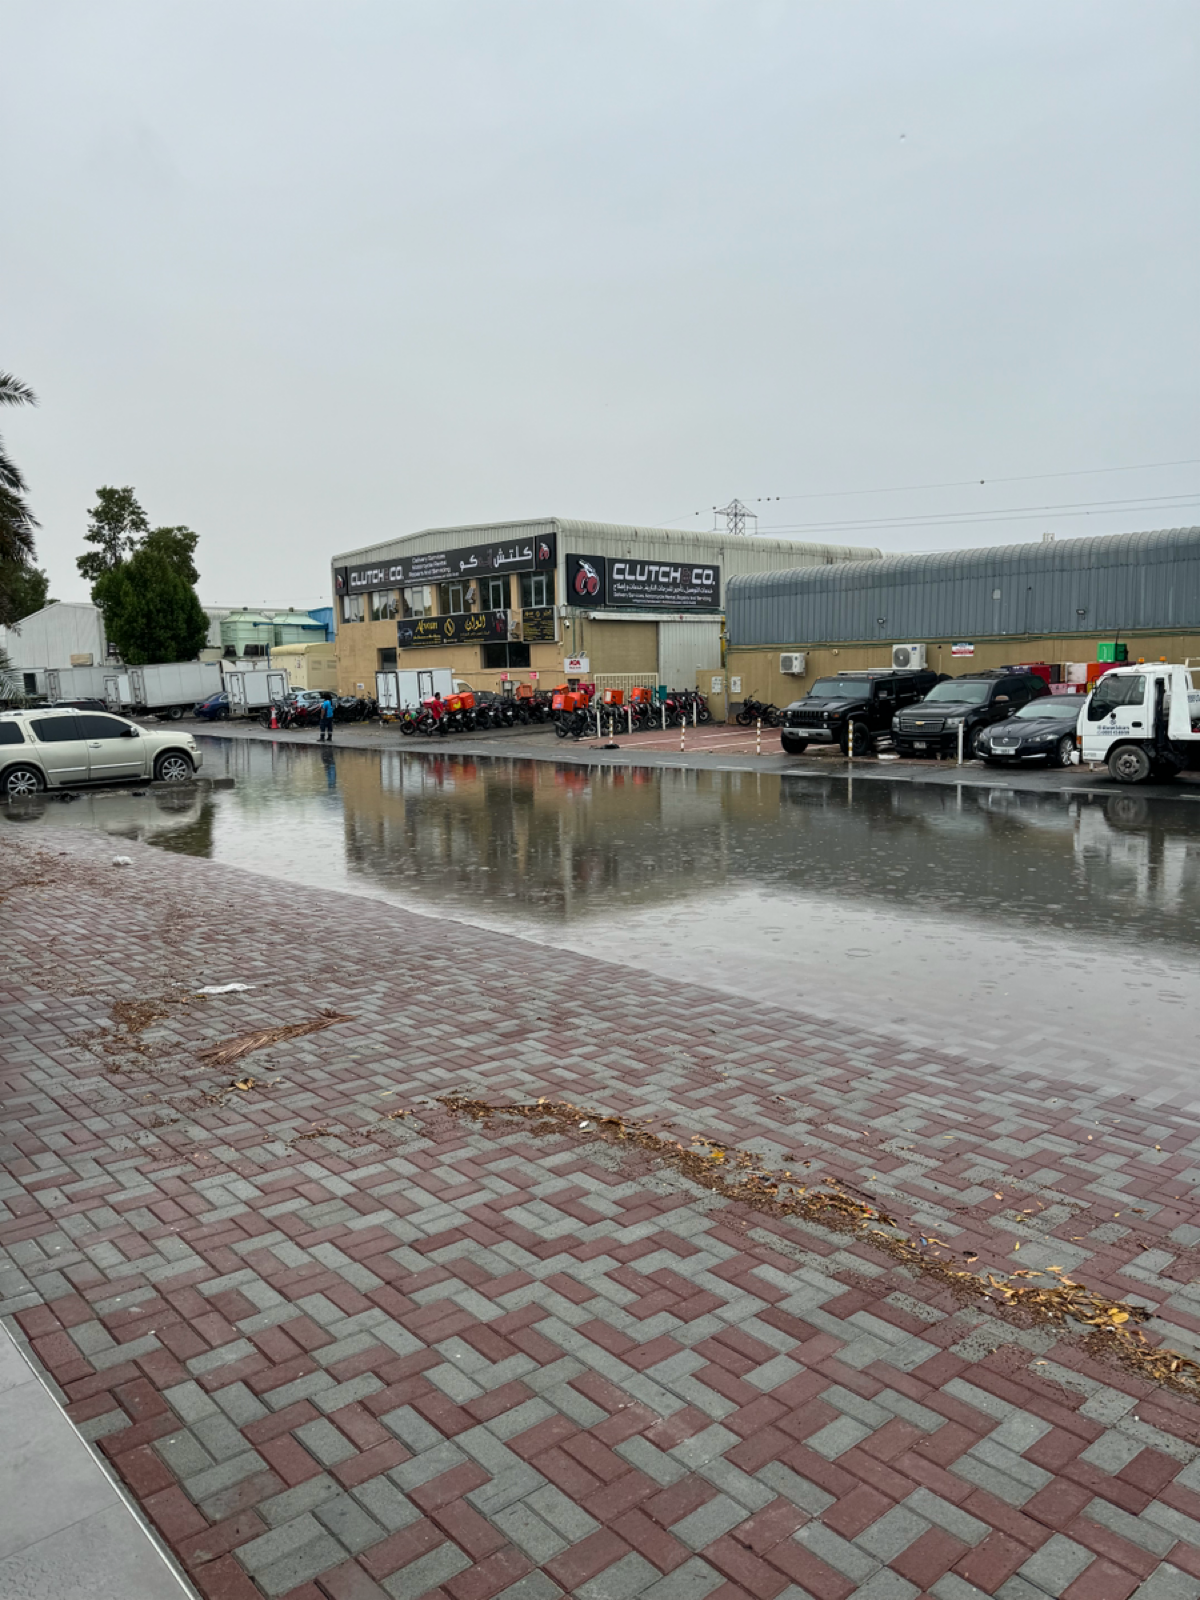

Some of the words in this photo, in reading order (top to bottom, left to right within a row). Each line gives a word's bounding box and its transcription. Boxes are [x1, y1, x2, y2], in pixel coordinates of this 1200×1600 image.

[459, 554, 478, 572] كو
[493, 545, 533, 568] كلتش
[350, 568, 385, 586] CLUTCH
[389, 565, 404, 581] CO.
[612, 563, 682, 584] CLUTCH
[692, 568, 715, 585] CO.
